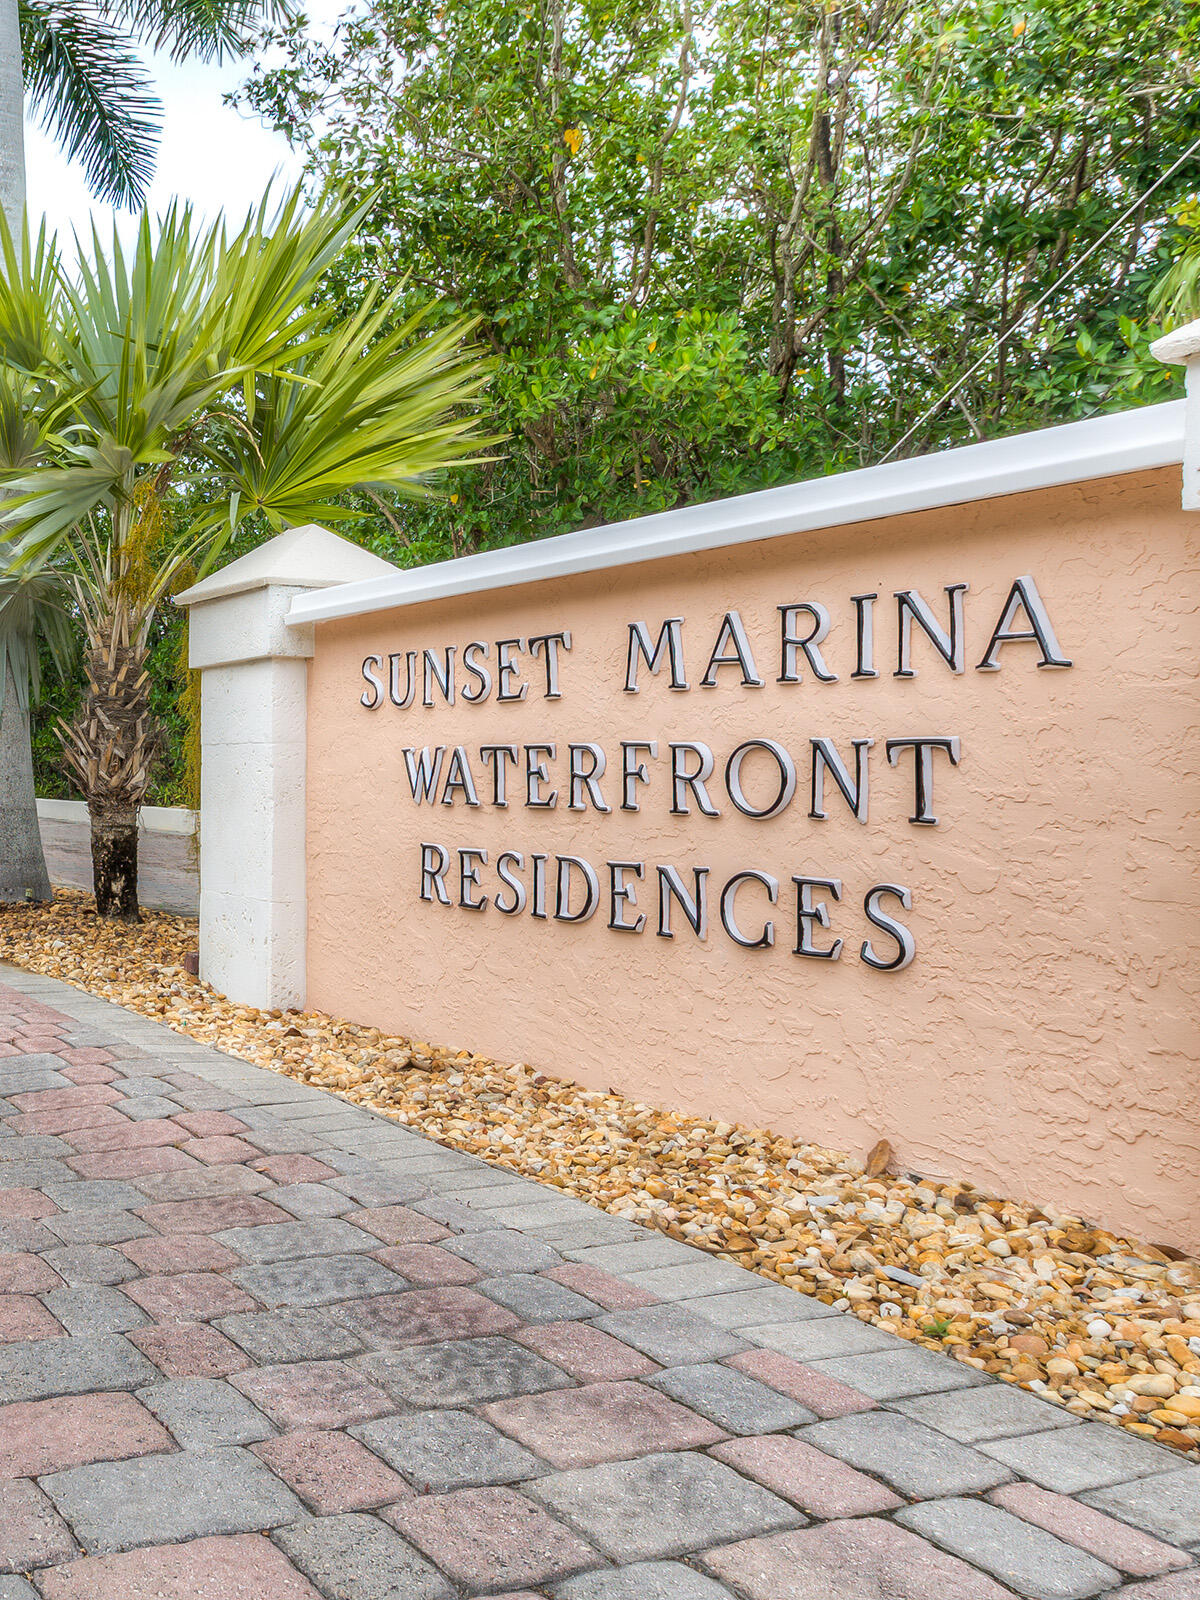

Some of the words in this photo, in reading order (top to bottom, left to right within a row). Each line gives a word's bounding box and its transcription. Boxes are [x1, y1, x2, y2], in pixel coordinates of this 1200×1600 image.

[360, 631, 572, 711] SUNSET
[622, 575, 1074, 693] MARINA
[401, 736, 961, 826] WATERFRONT
[418, 842, 917, 972] RESIDENCES
